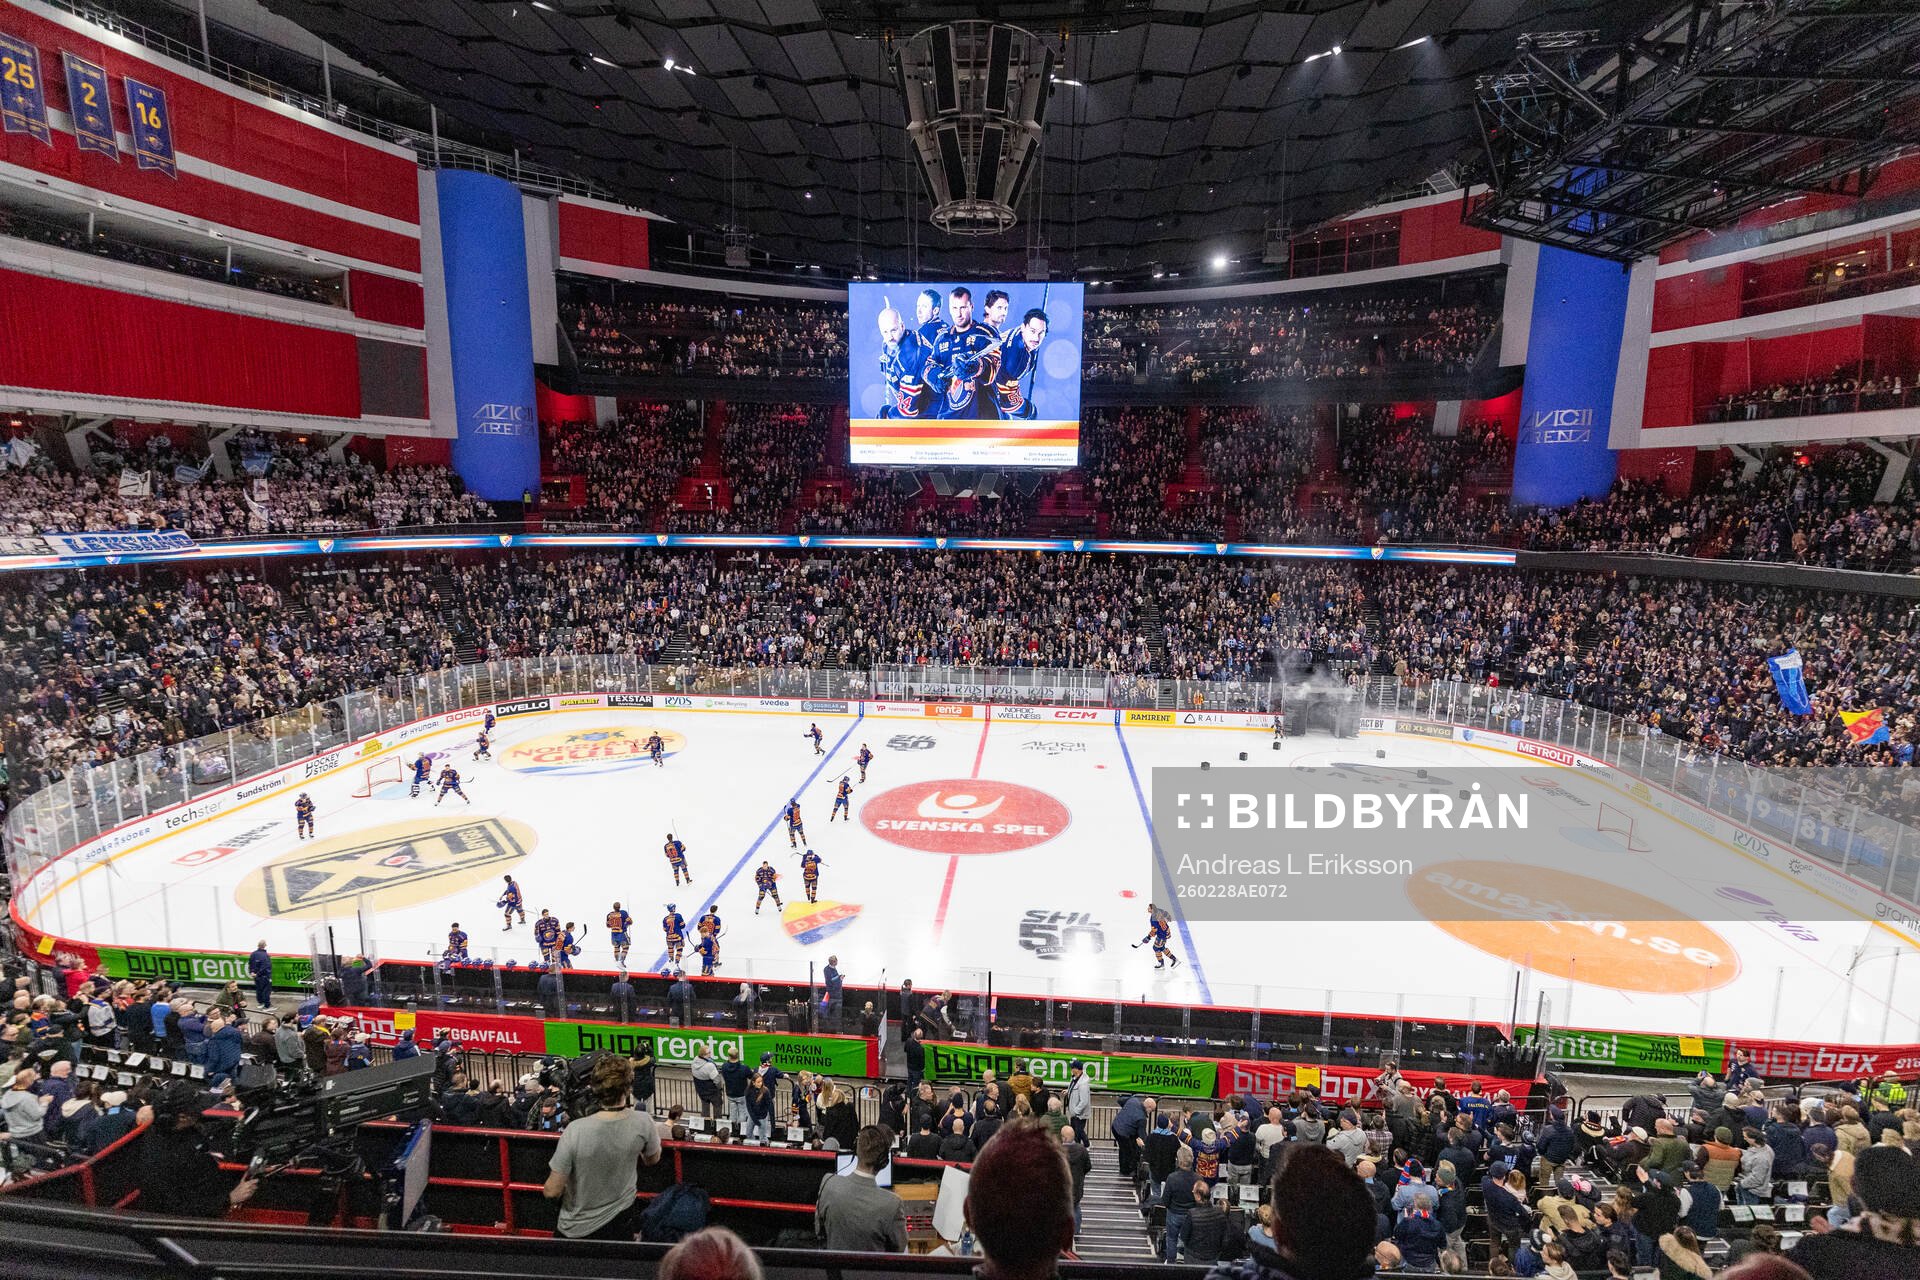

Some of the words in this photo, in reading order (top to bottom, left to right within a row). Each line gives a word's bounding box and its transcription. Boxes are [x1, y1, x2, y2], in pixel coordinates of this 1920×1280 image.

[2, 57, 35, 89] 25
[81, 82, 97, 107] 2
[136, 102, 162, 129] 16
[62, 530, 194, 554] LEKSAND
[955, 684, 982, 694] RYDS
[609, 695, 652, 703] TEXSTAR
[665, 697, 692, 706] RYDS
[760, 699, 790, 707] svedea
[498, 701, 549, 716] DIVELLO
[935, 705, 962, 715] renta
[1004, 706, 1034, 714] NORDIC
[1054, 711, 1098, 719] CCM
[1131, 713, 1171, 722] RAMIRENT
[409, 721, 440, 737] HYUNDAI
[1412, 723, 1450, 735] XL-BYGG
[1518, 742, 1573, 765] METROLIT
[306, 752, 340, 774] HOCKEY
[314, 760, 339, 775] STORE
[236, 778, 281, 801] Sundström
[165, 799, 223, 829] techster
[875, 819, 985, 833] SVENSKA
[992, 822, 1049, 836] SPEL
[1733, 829, 1770, 857] RYDS
[1021, 909, 1103, 926] SHL
[1424, 871, 1722, 967] amazon.se
[433, 1026, 522, 1045] BGGAVFALL
[775, 1042, 823, 1057] MASKIN
[1651, 1042, 1680, 1054] MAS
[774, 1053, 833, 1068] THYRNING
[1142, 1063, 1193, 1078] MASKIN
[1130, 1073, 1201, 1090] UTHYRNING
